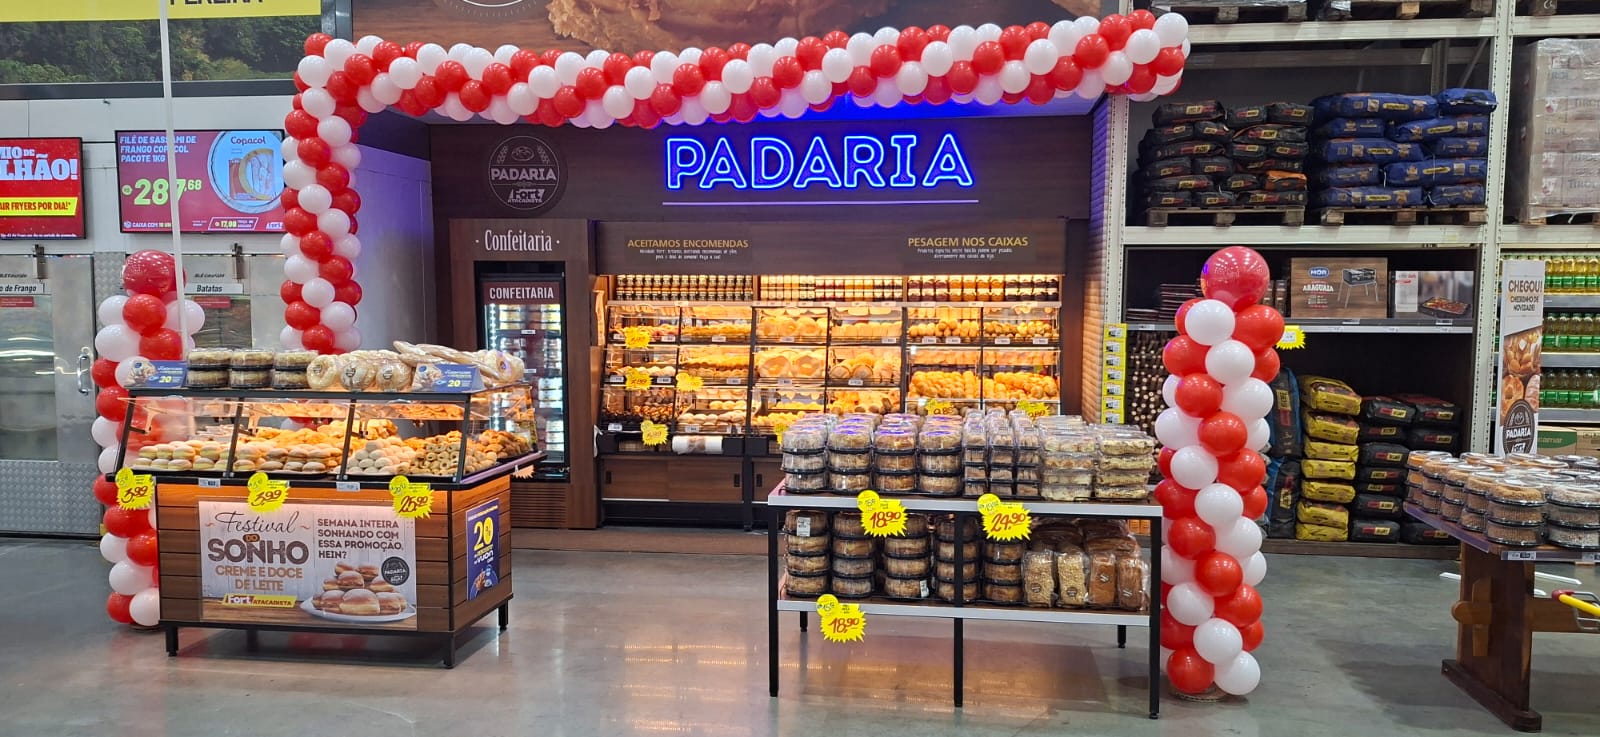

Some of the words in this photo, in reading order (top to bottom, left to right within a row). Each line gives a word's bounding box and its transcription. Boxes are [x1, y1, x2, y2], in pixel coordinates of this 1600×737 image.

[120, 135, 137, 144] FILÉ
[230, 136, 266, 145] Copacol
[666, 134, 972, 189] PADARIA
[491, 168, 556, 180] PADARIA
[11, 202, 36, 210] FRYERS
[38, 202, 52, 210] POR
[485, 229, 552, 251] Confeitaria
[628, 240, 680, 248] ACEITAMOS
[683, 240, 748, 248] ENCOMENDAS
[908, 238, 958, 247] PESAGEM
[962, 238, 985, 246] NOS
[988, 237, 1028, 246] CAIXAS
[14, 284, 37, 293] Frango
[490, 287, 554, 299] CONFEITARIA
[215, 511, 299, 533] Festival
[318, 518, 359, 527] SEMANA
[360, 520, 399, 529] INTEIRA
[318, 529, 374, 539] SONHANDO
[376, 530, 399, 540] COM
[318, 540, 342, 548] ESSA
[208, 538, 309, 565] SONHO
[318, 551, 347, 559] HEIN?
[216, 565, 254, 577] CREME
[259, 566, 266, 577] E
[268, 567, 303, 579] DOCE
[235, 580, 250, 590] DE
[253, 580, 284, 591] LEITE
[828, 617, 860, 633] 18,90
